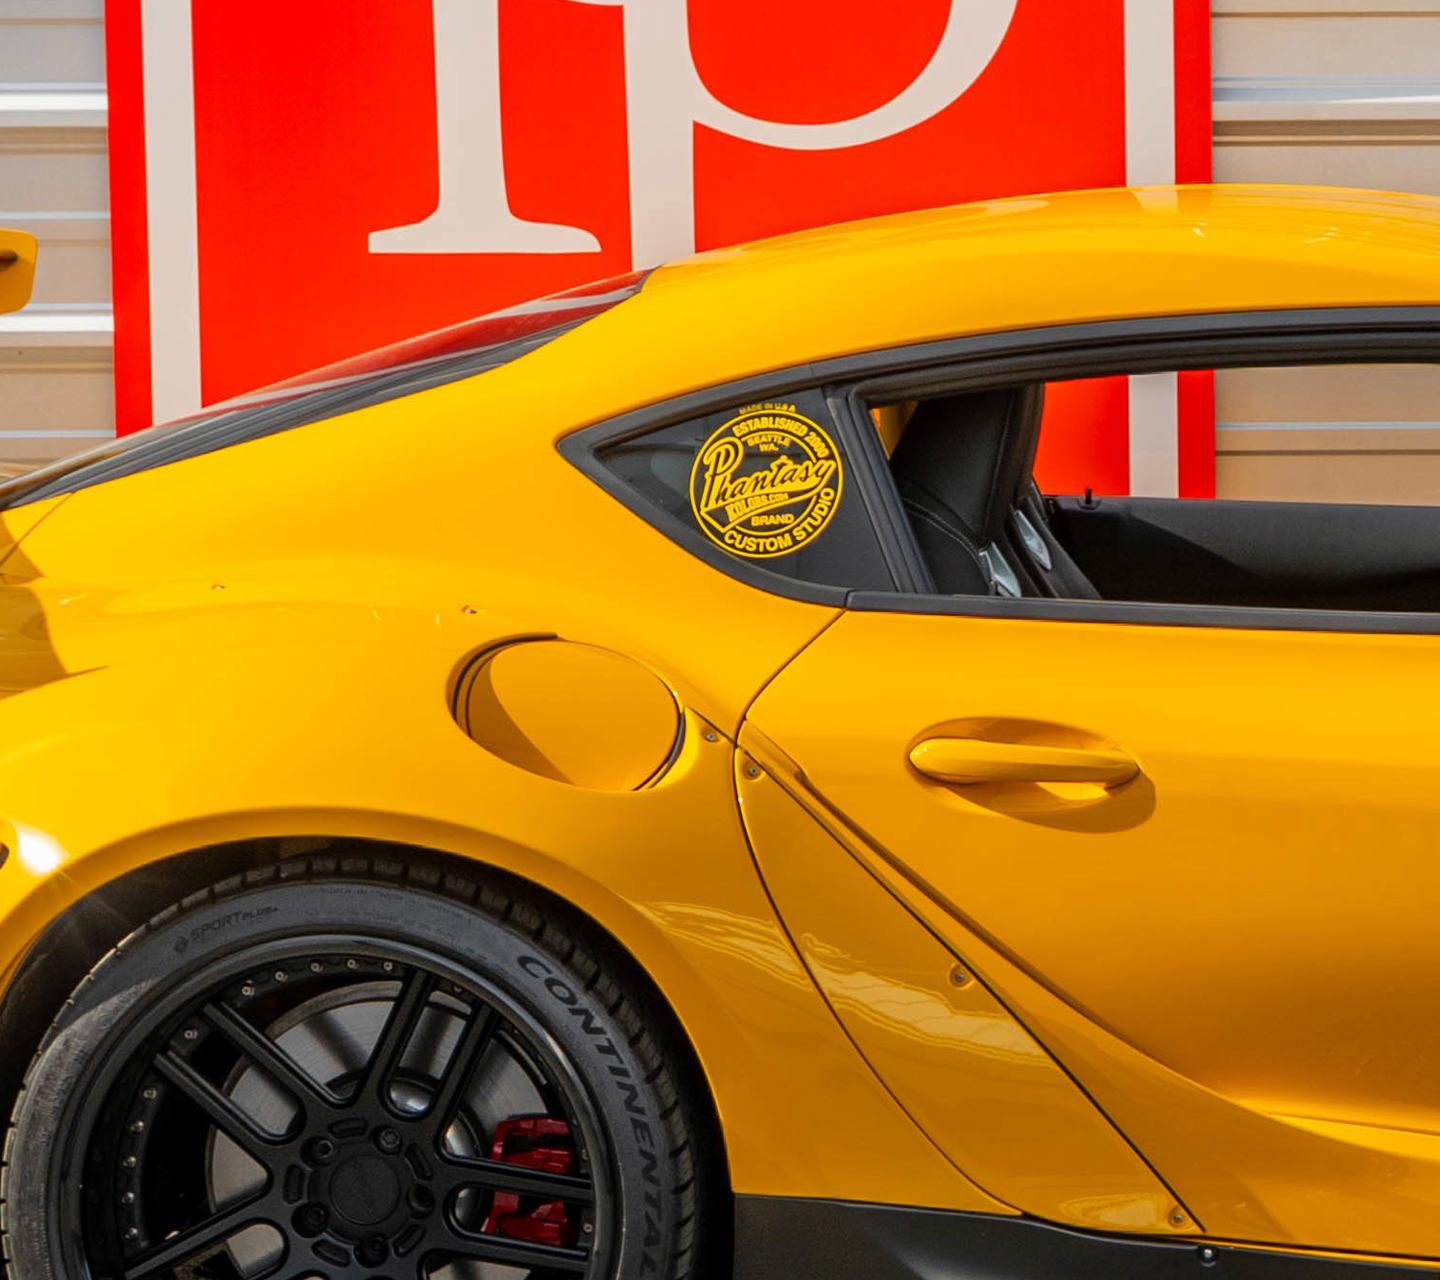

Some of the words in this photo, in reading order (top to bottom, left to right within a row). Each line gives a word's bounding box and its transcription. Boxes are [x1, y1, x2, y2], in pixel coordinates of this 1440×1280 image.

[731, 416, 809, 438] ESTABLISHED
[803, 430, 831, 459] 2000
[746, 434, 792, 449] SEATTLE
[702, 437, 837, 511] Phantasy
[723, 530, 793, 552] CUSTOM
[792, 487, 836, 541] STUDIO
[750, 513, 795, 527] BRAND
[517, 955, 661, 1276] CONTINENTAL
